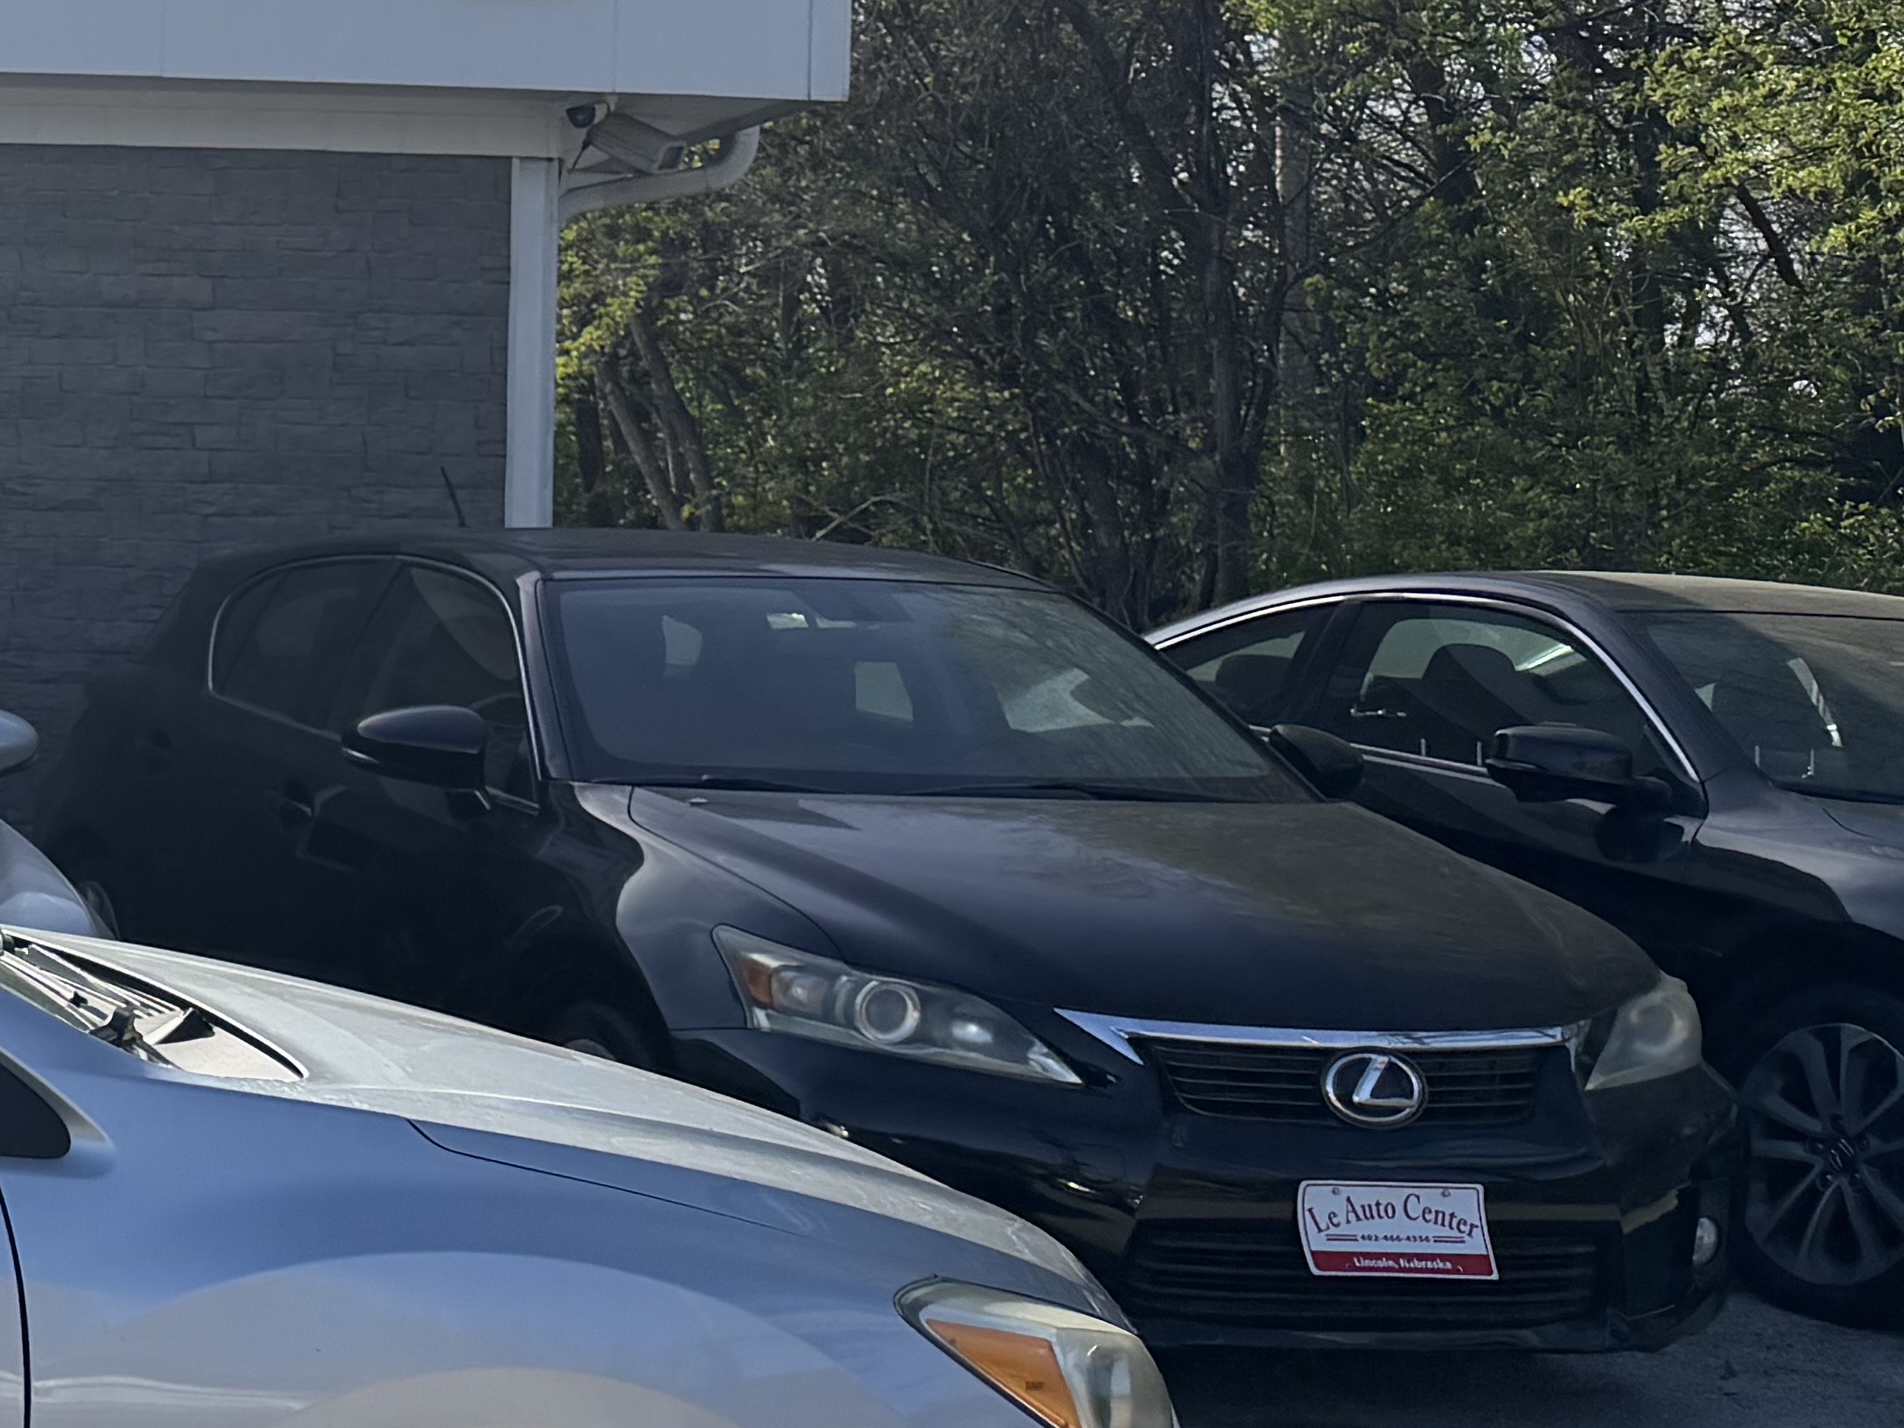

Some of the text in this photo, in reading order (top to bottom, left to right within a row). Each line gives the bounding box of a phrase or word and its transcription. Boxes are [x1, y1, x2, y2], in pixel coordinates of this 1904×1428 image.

[1307, 1192, 1479, 1239] Le Auto Center
